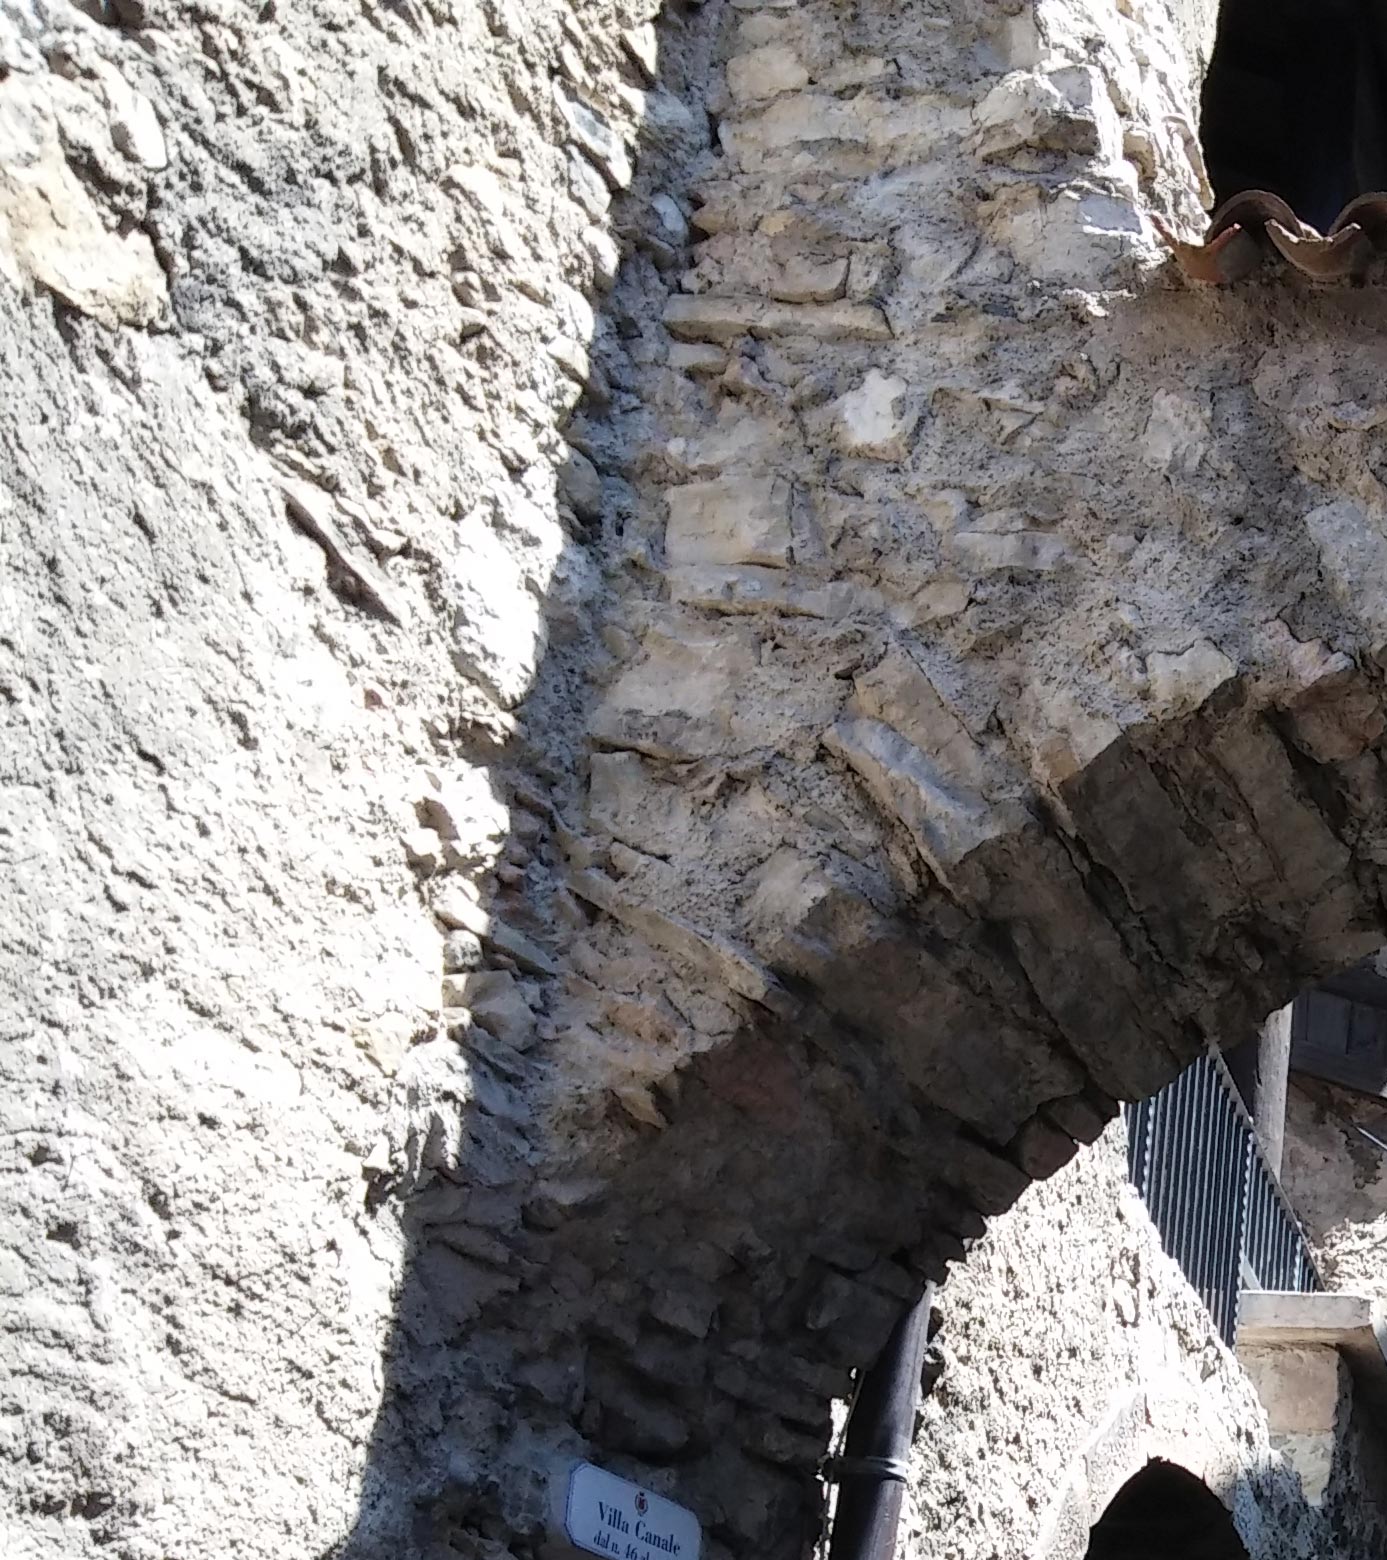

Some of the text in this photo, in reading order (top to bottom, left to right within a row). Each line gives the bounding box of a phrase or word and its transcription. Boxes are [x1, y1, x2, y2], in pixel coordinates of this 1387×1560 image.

[593, 1530, 610, 1549] dal
[598, 1501, 681, 1557] Villa Canale
